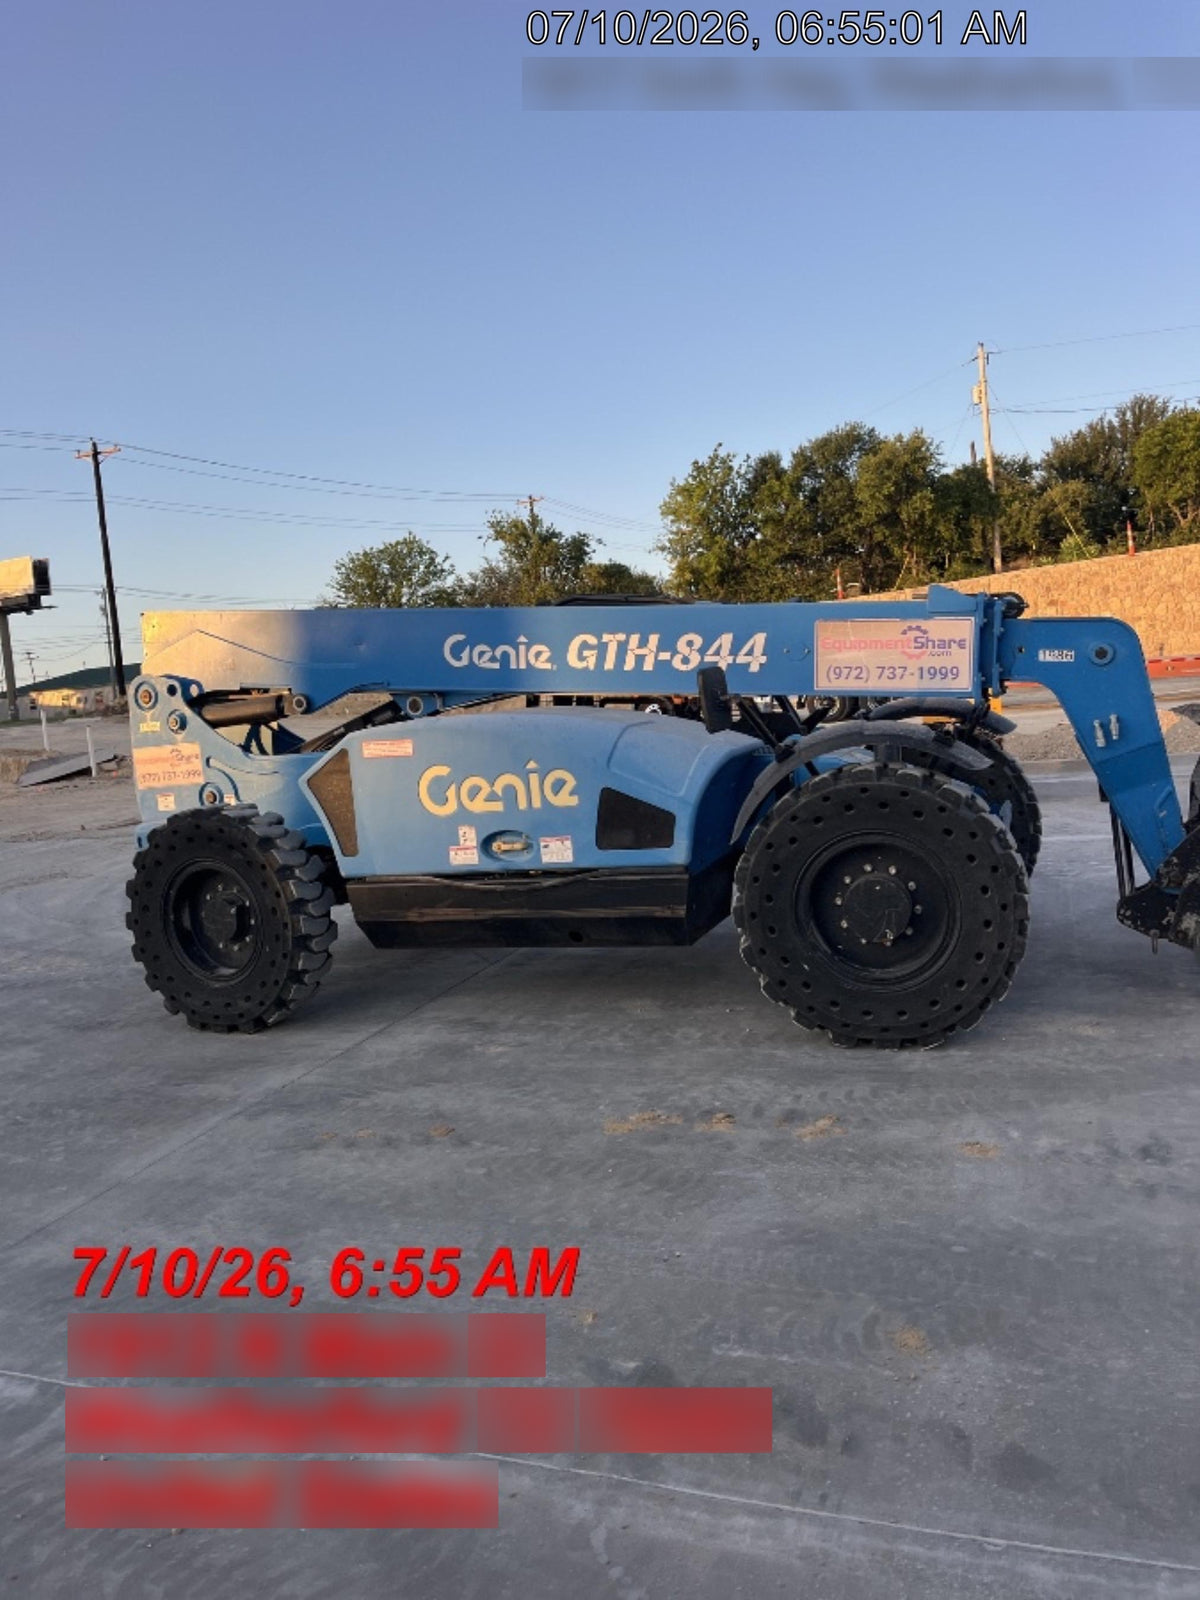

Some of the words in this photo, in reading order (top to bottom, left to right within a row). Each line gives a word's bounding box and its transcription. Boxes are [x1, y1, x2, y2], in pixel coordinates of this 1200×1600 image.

[443, 633, 552, 670] Genie
[567, 631, 767, 673] GTH-844
[826, 664, 870, 683] (972)
[875, 665, 960, 681] 737-1999
[417, 758, 579, 817] Genie
